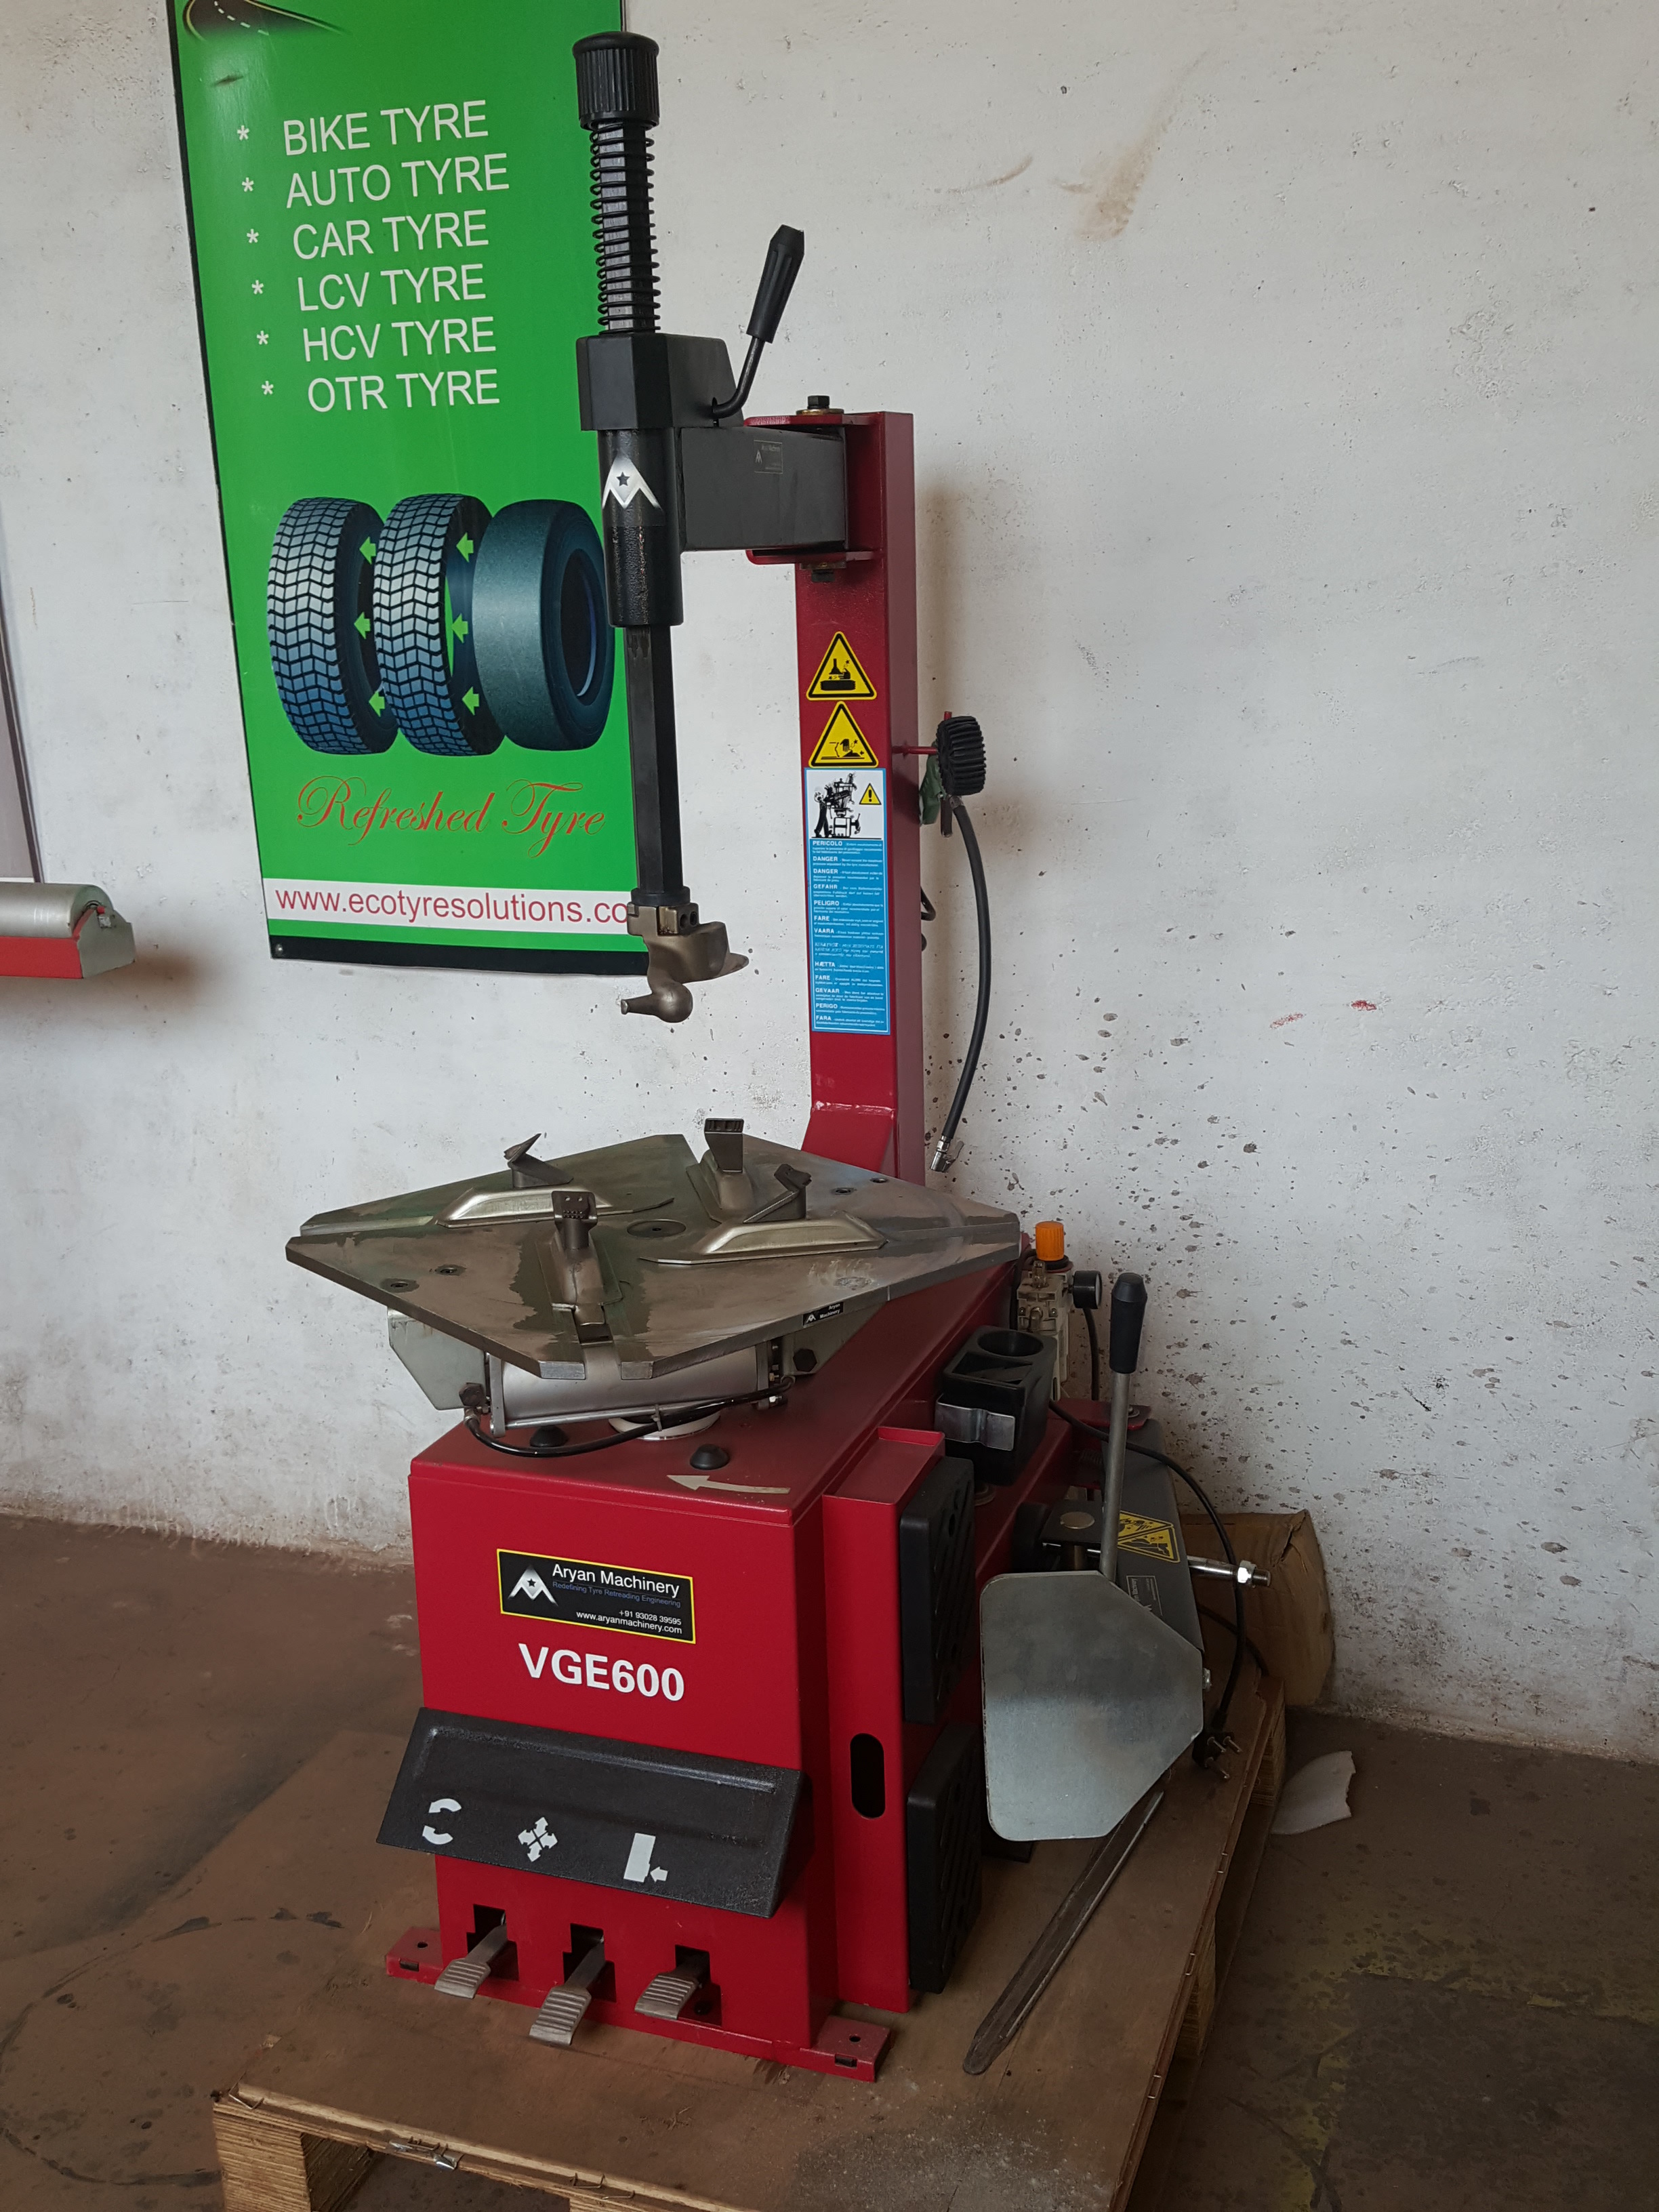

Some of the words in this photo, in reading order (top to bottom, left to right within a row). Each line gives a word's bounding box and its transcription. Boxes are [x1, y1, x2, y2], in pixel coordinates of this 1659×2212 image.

[283, 112, 370, 156] BIKE
[380, 100, 489, 145] TYRE
[286, 165, 391, 209] AUTO
[401, 152, 510, 197] TYRE
[293, 220, 374, 260] CAR
[382, 209, 489, 252] TYRE
[298, 272, 369, 311] LCV
[380, 263, 486, 305] TYRE
[303, 323, 381, 362] HCV
[391, 316, 496, 356] TYRE
[308, 375, 388, 412] OTR
[395, 369, 500, 408] TYRE
[297, 775, 494, 846] Refreshed
[501, 779, 605, 858] Tyre
[275, 889, 628, 924] www.ecotyresolutions.co
[552, 1563, 596, 1582] Aryan
[600, 1570, 680, 1598] Machinery
[552, 1581, 587, 1593] Redefining
[588, 1586, 603, 1595] Tyre
[604, 1589, 640, 1602] Retreading
[641, 1595, 681, 1608] Engineering
[576, 1611, 682, 1634] www.aryanmachinery.com
[619, 1610, 633, 1618] +91
[636, 1612, 658, 1622] 93028
[659, 1616, 682, 1625] 39595
[518, 1643, 684, 1701] VGE600
